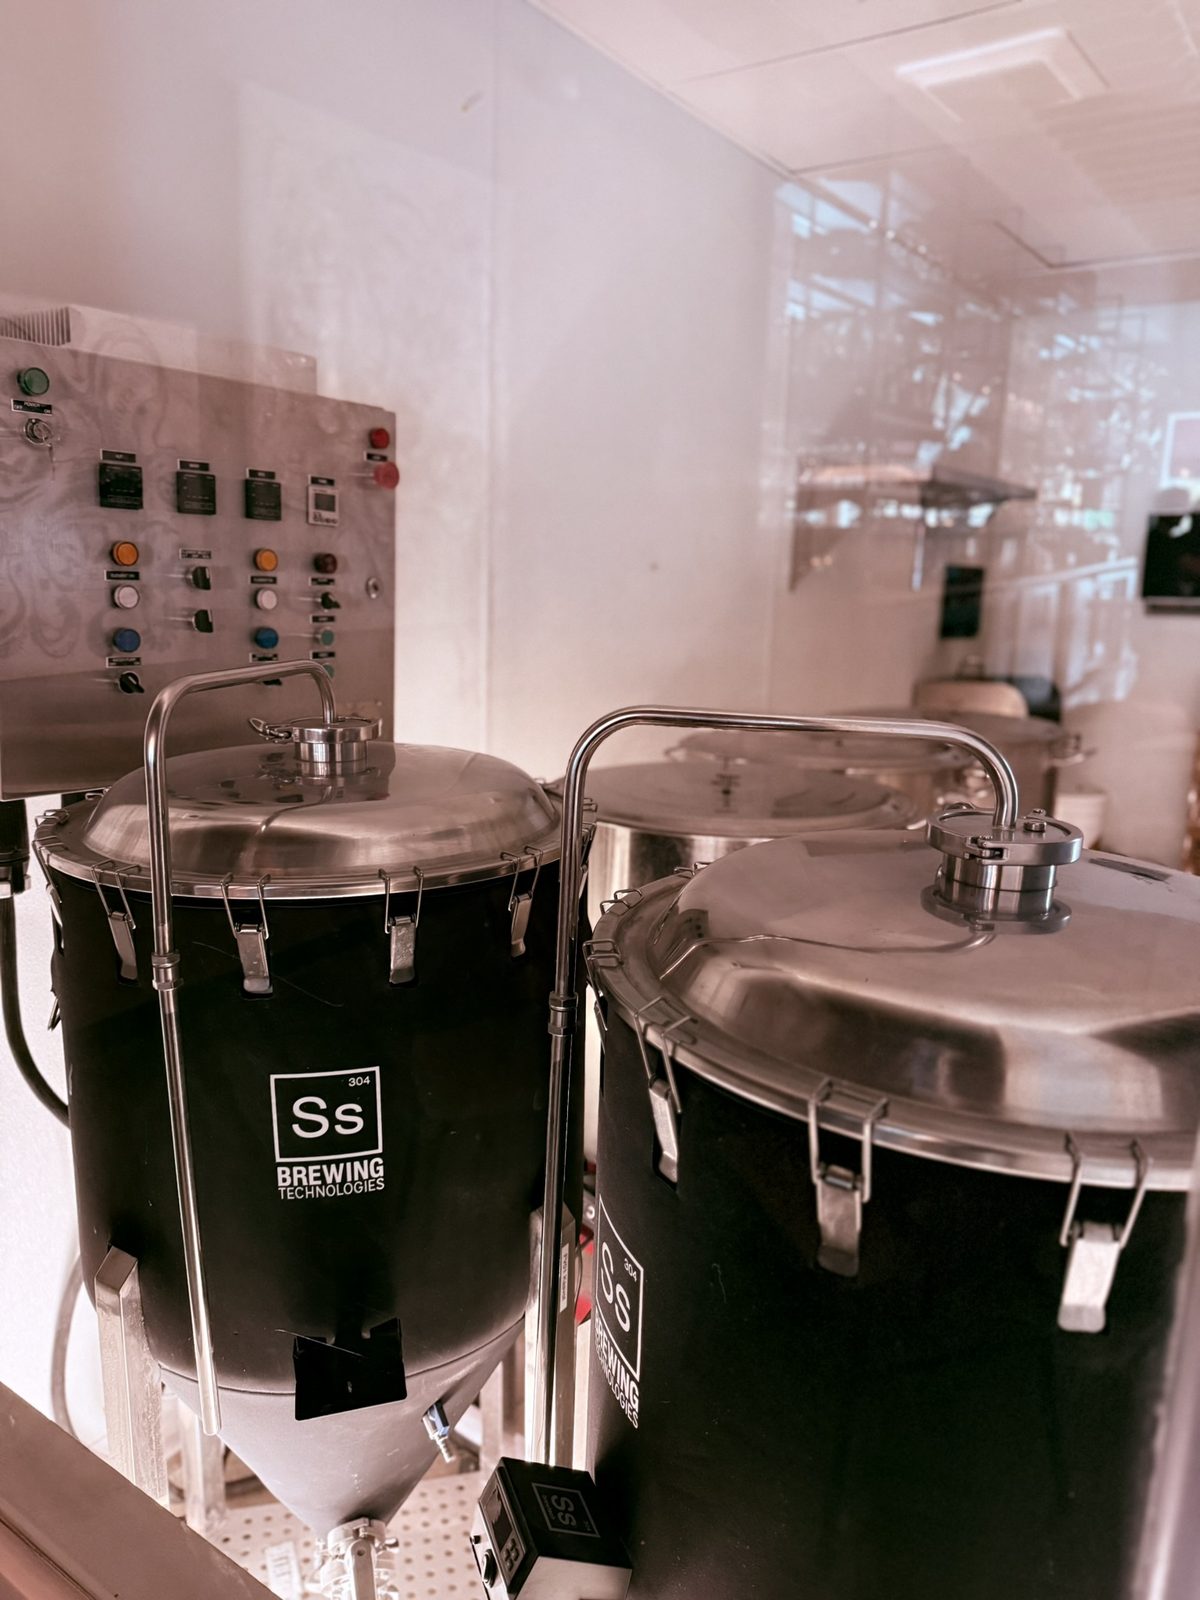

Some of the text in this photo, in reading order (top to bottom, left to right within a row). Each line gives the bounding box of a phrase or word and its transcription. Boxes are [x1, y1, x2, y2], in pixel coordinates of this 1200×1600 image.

[348, 1076, 370, 1087] 304
[292, 1096, 364, 1138] Ss
[277, 1157, 384, 1187] BREWING
[278, 1178, 385, 1199] TECHNOLOGIES
[624, 1258, 637, 1282] 304
